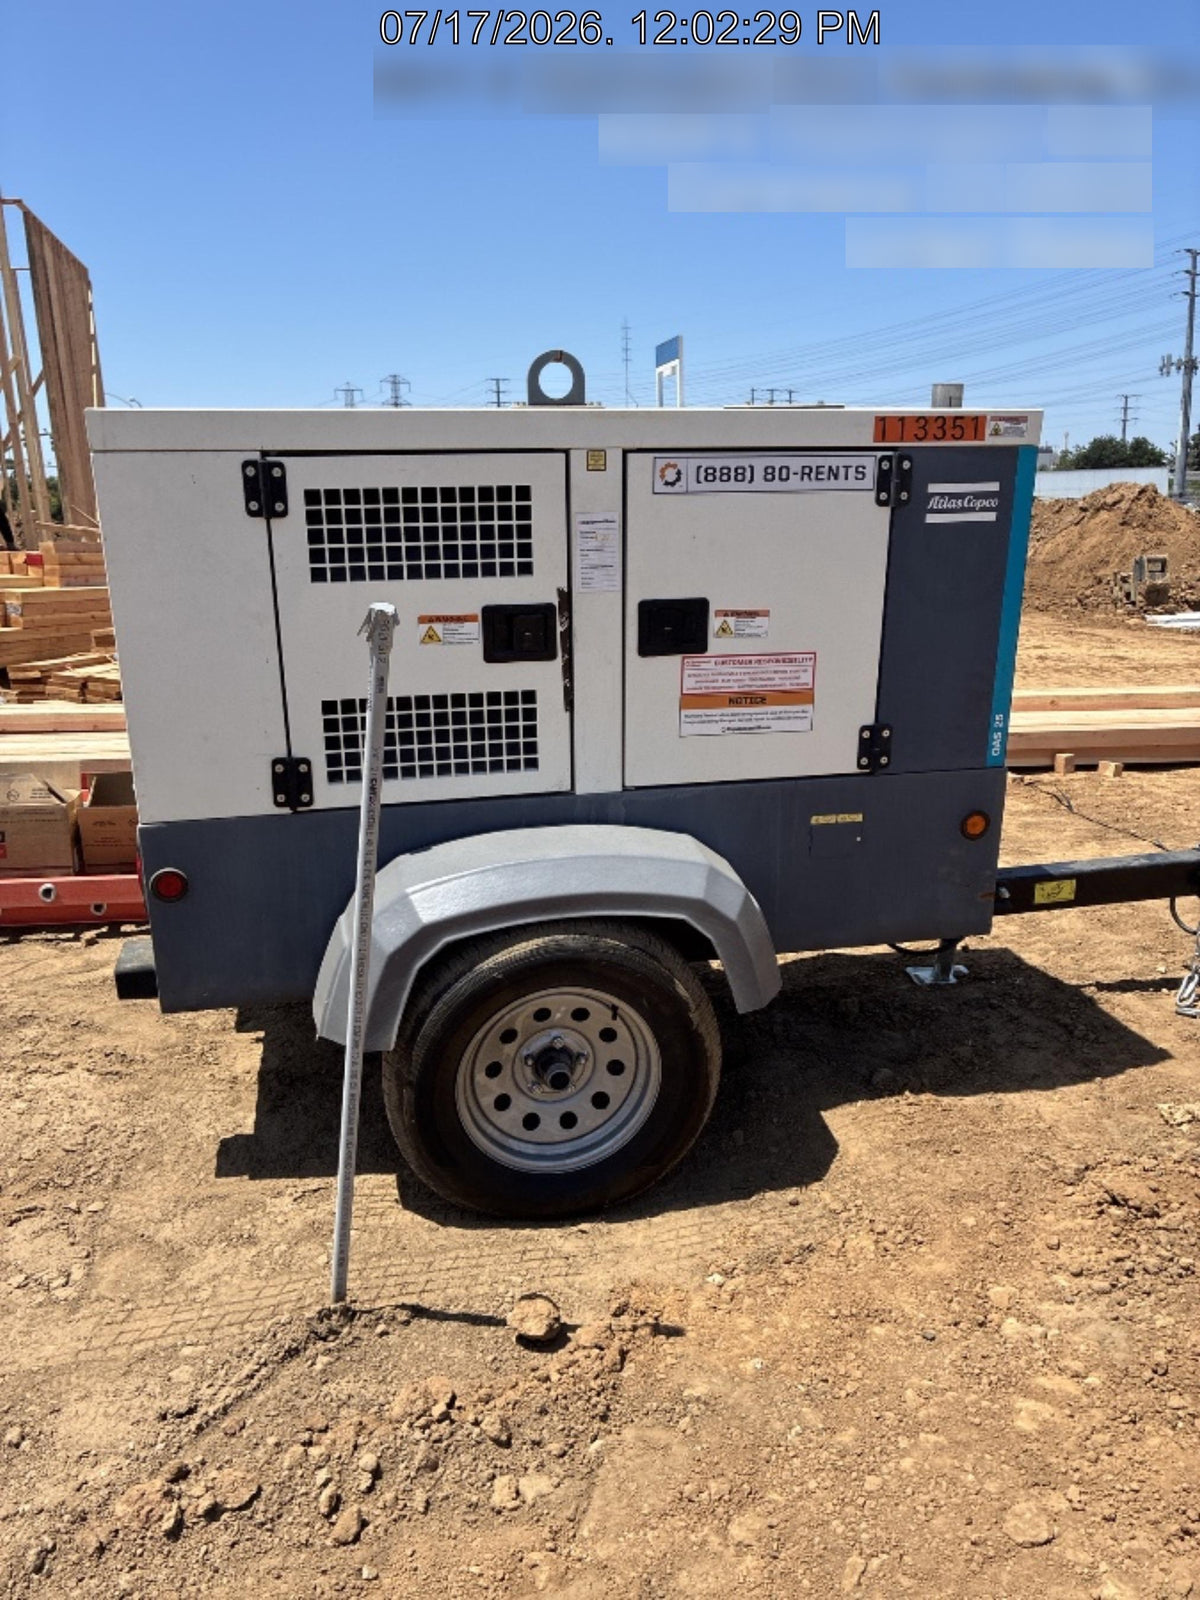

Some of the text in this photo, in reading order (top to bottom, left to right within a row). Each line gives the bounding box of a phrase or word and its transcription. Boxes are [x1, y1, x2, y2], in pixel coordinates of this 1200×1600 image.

[878, 416, 979, 441] 113351
[696, 465, 867, 484] (888) 80-RENTS
[927, 495, 998, 511] Atlas Copco
